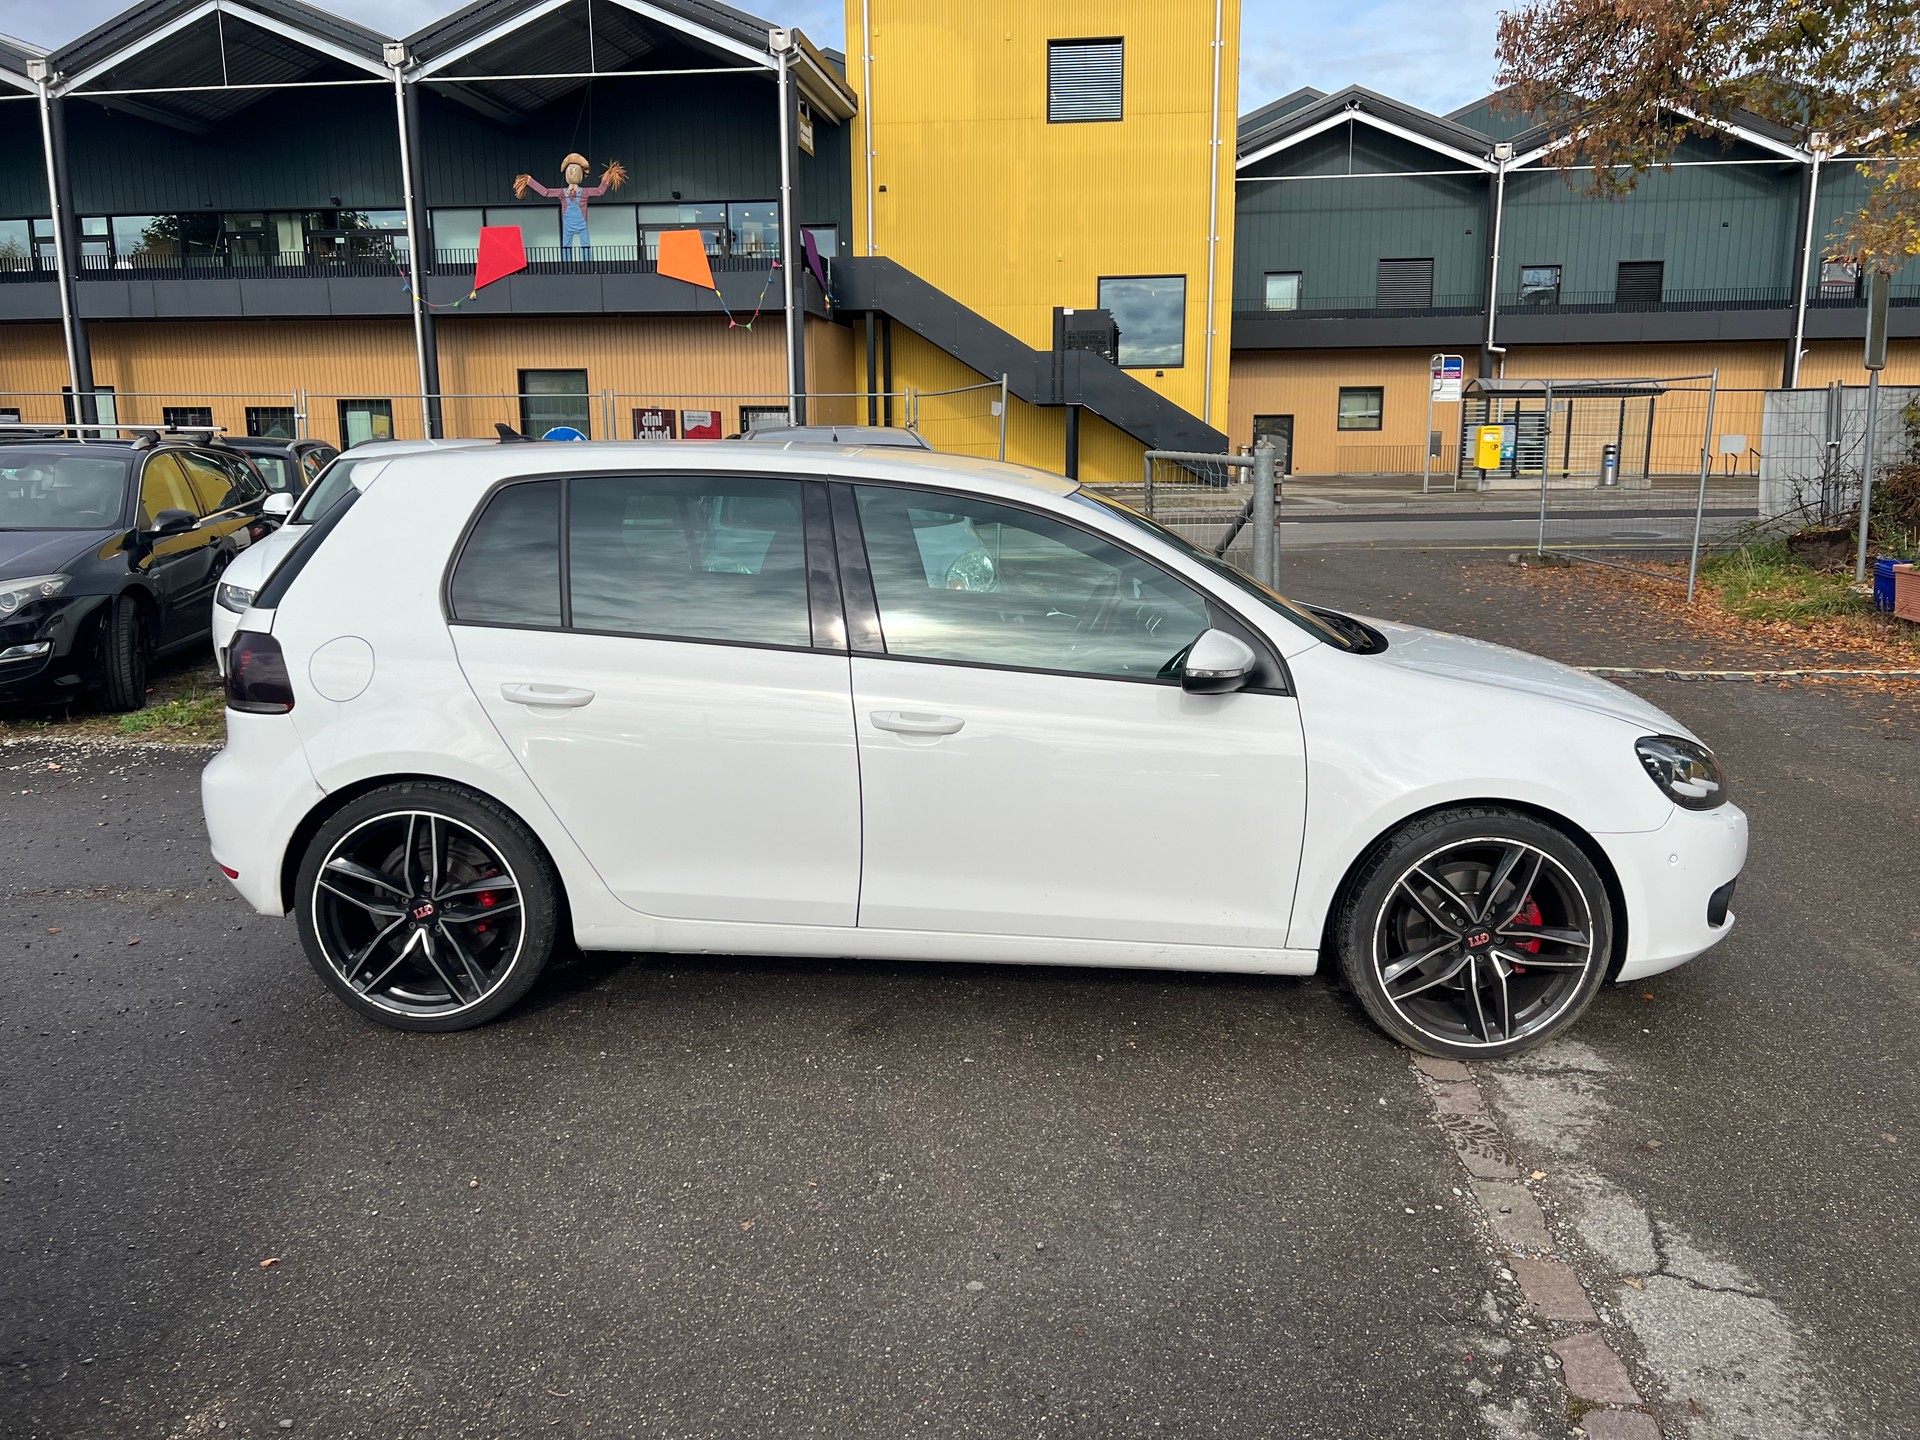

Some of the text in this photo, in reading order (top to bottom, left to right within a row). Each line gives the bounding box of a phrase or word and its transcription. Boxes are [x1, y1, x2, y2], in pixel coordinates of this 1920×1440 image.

[641, 411, 663, 427] dini
[638, 425, 671, 440] chind
[412, 903, 435, 920] GTI
[1467, 932, 1490, 948] GTI
